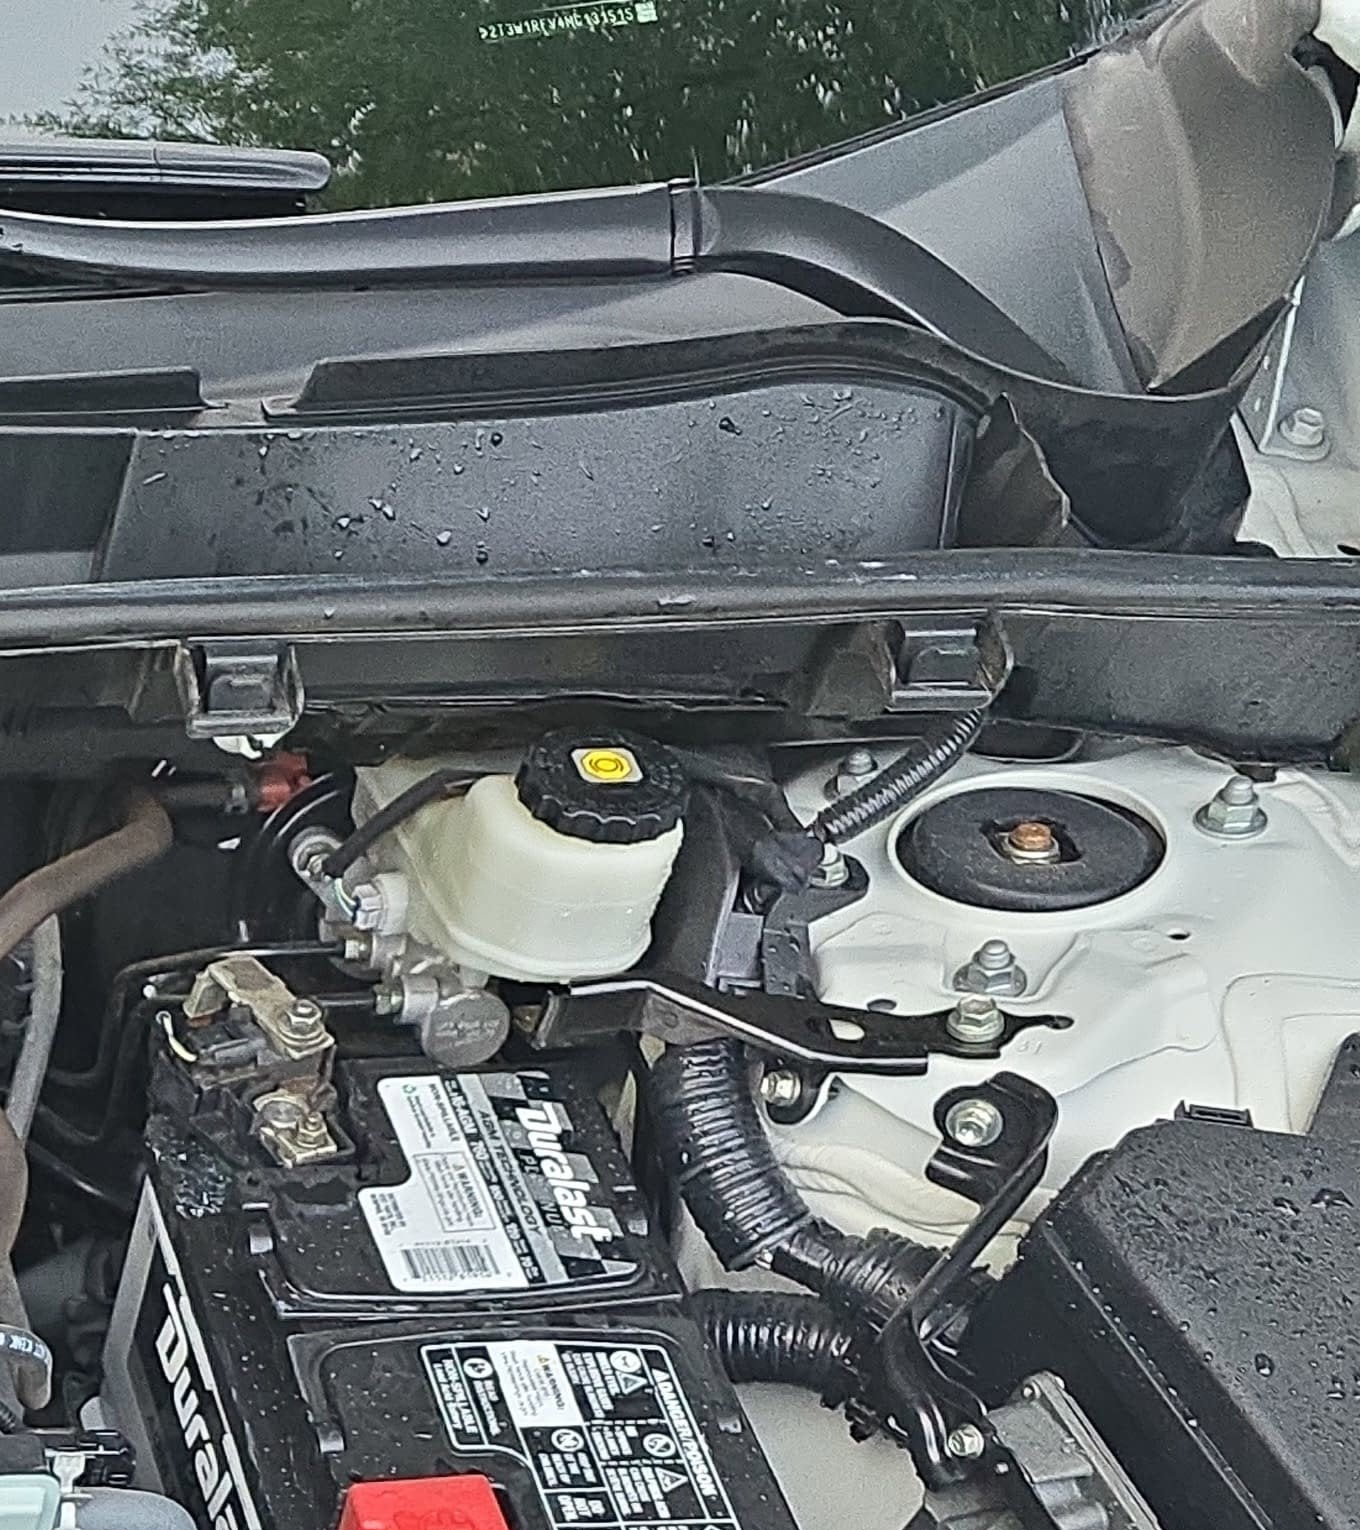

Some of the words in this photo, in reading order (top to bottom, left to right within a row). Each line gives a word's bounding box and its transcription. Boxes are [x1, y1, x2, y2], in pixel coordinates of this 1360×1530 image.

[479, 1111, 501, 1146] AGM
[495, 1144, 543, 1239] TECHNOLOGY
[516, 1102, 612, 1243] Duralast
[442, 1359, 478, 1433] NON-SPILLABLE
[659, 1383, 718, 1496] DANGER/POISON
